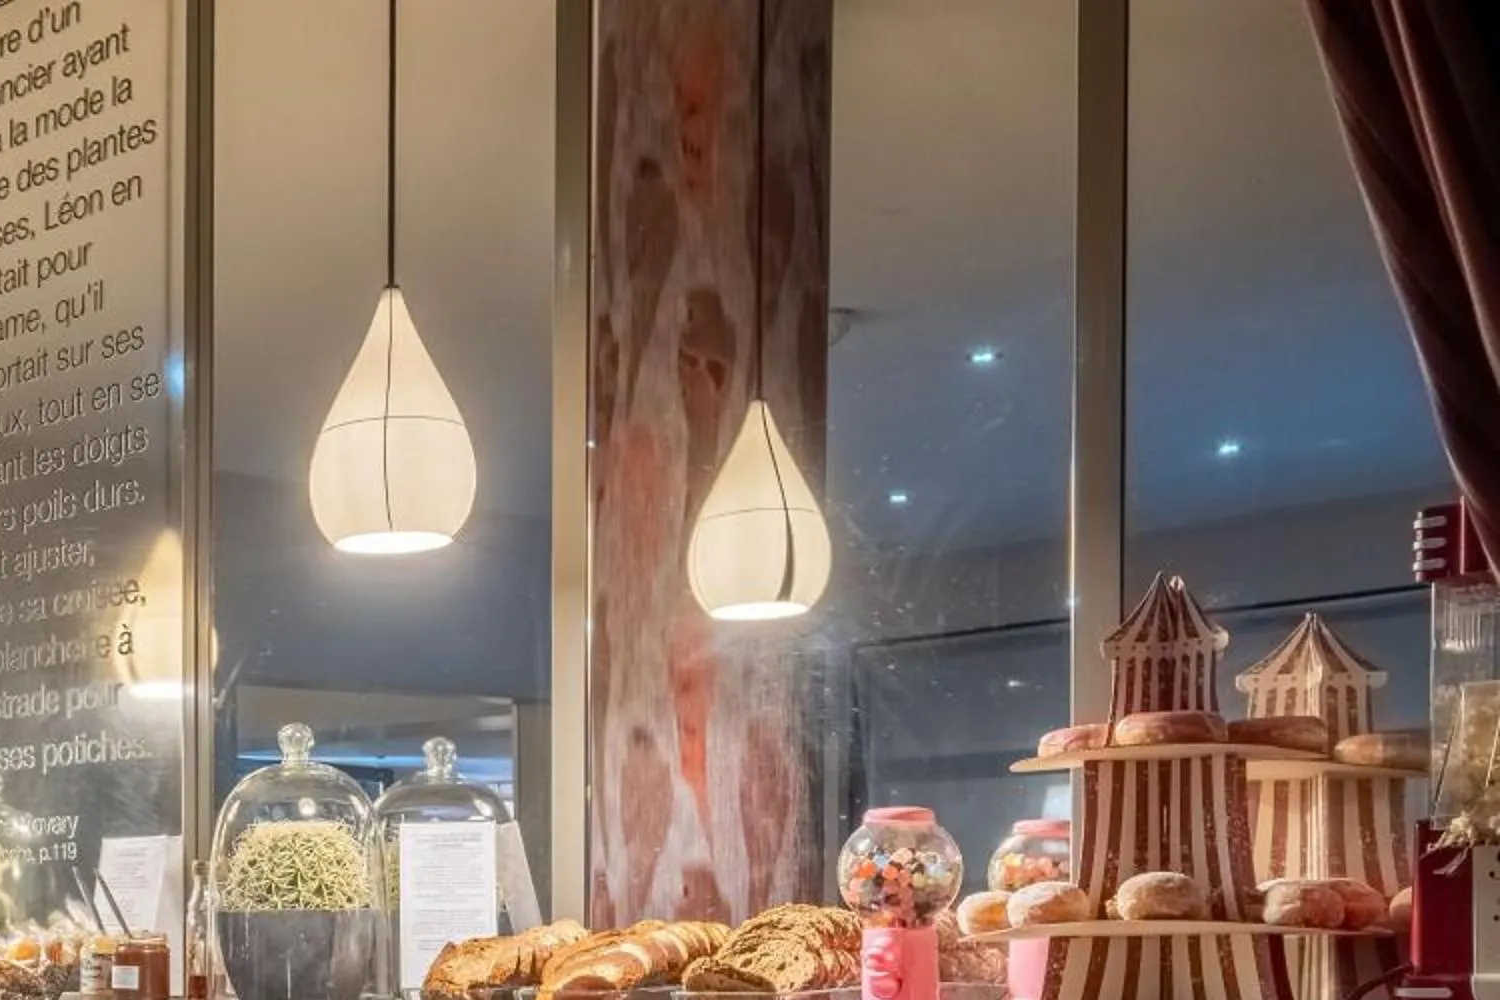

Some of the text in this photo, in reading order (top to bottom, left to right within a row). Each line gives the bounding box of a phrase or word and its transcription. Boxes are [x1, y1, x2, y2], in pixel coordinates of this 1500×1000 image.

[28, 1, 81, 43] d'un
[62, 23, 130, 79] ayant
[9, 119, 28, 149] la
[35, 88, 104, 138] mode
[111, 76, 133, 107] la
[16, 157, 60, 192] des
[67, 119, 157, 181] plantes
[44, 192, 103, 232] Léon
[111, 175, 143, 207] en
[37, 242, 93, 288] pour
[55, 279, 104, 327] qu'il
[57, 337, 94, 372] sur
[101, 325, 145, 360] ses
[38, 387, 85, 426] tout
[92, 382, 123, 413] en
[130, 371, 161, 401] se
[32, 446, 65, 476] les
[73, 423, 149, 466] doigts
[23, 488, 77, 535] poils
[84, 479, 145, 513] durs.
[117, 623, 134, 656] à
[42, 730, 153, 774] potiches.
[19, 812, 79, 839] ovary
